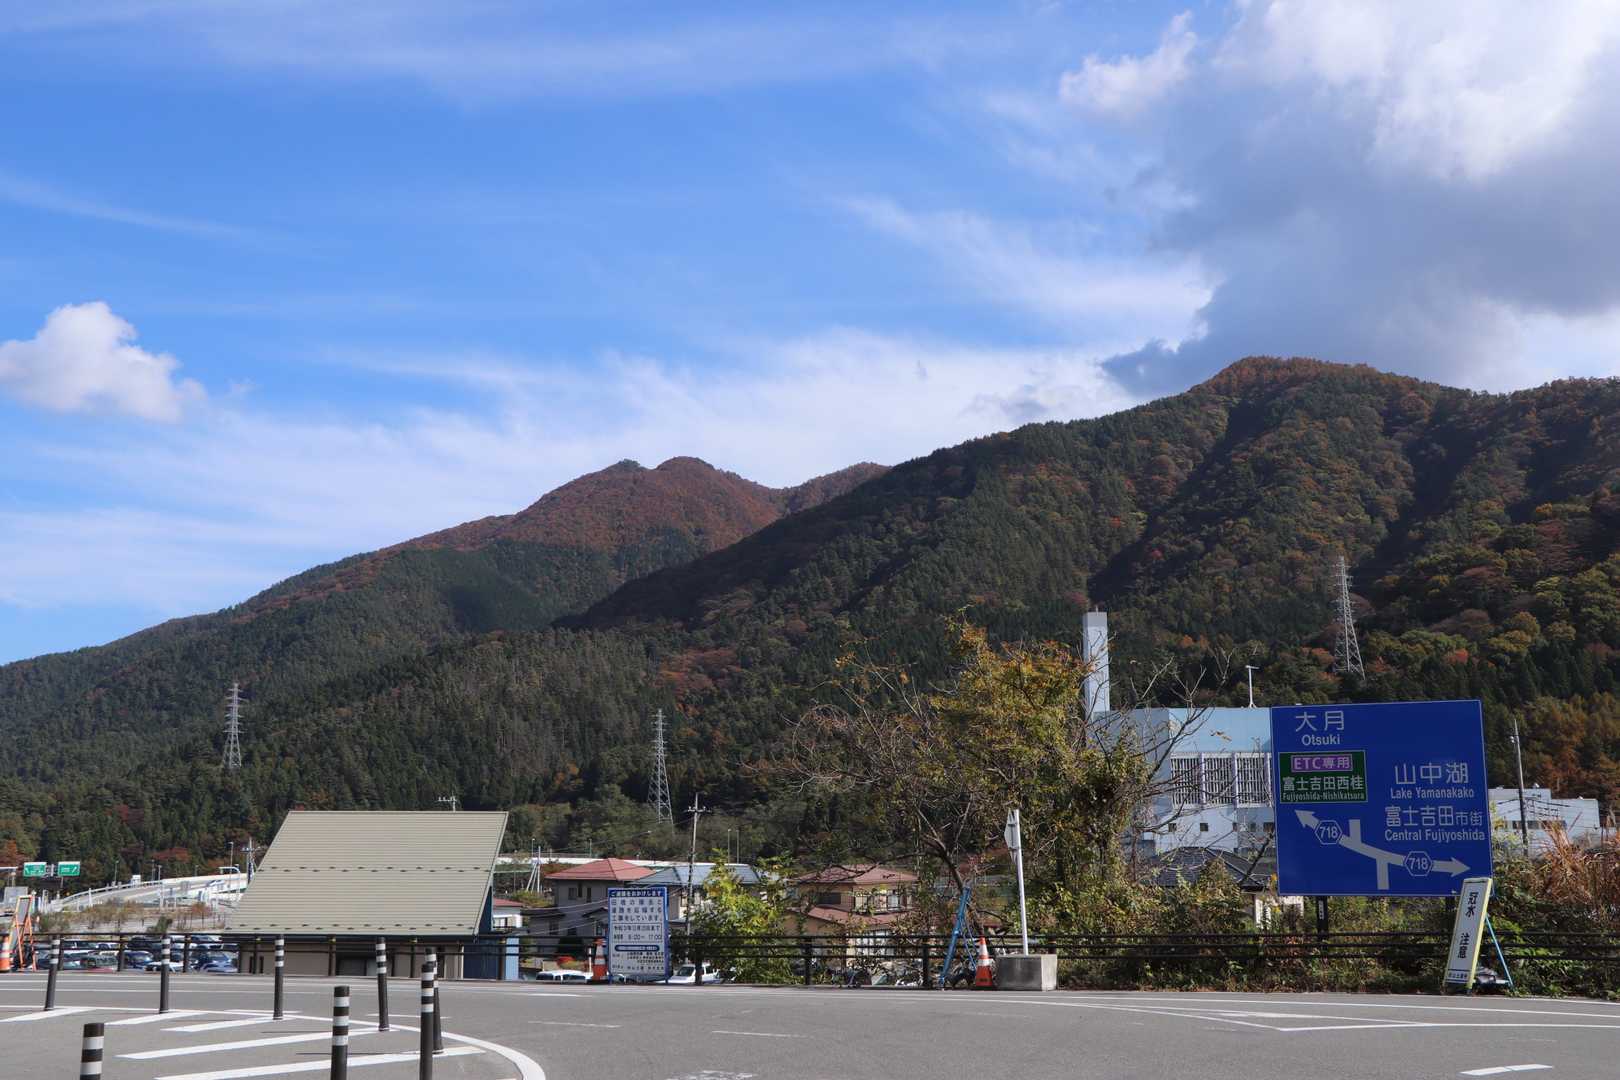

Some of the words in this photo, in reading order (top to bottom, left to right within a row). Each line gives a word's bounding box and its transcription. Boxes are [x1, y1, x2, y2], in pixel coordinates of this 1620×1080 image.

[1295, 710, 1344, 732] 大月
[1301, 734, 1341, 746] Otsuki
[1293, 756, 1350, 769] ETC専用
[1394, 762, 1469, 785] 山中湖
[1282, 775, 1364, 791] 富士吉田西桂
[1282, 791, 1365, 801] Fujiyoshida-Nishikatsura
[1390, 787, 1413, 799] Lake
[1416, 786, 1475, 798] Yamanakako
[1384, 805, 1483, 827] 富士吉田市街
[1319, 826, 1339, 839] 718
[1384, 829, 1422, 841] Central
[1425, 828, 1485, 843] Fujiyoshida
[1408, 857, 1429, 870] 718
